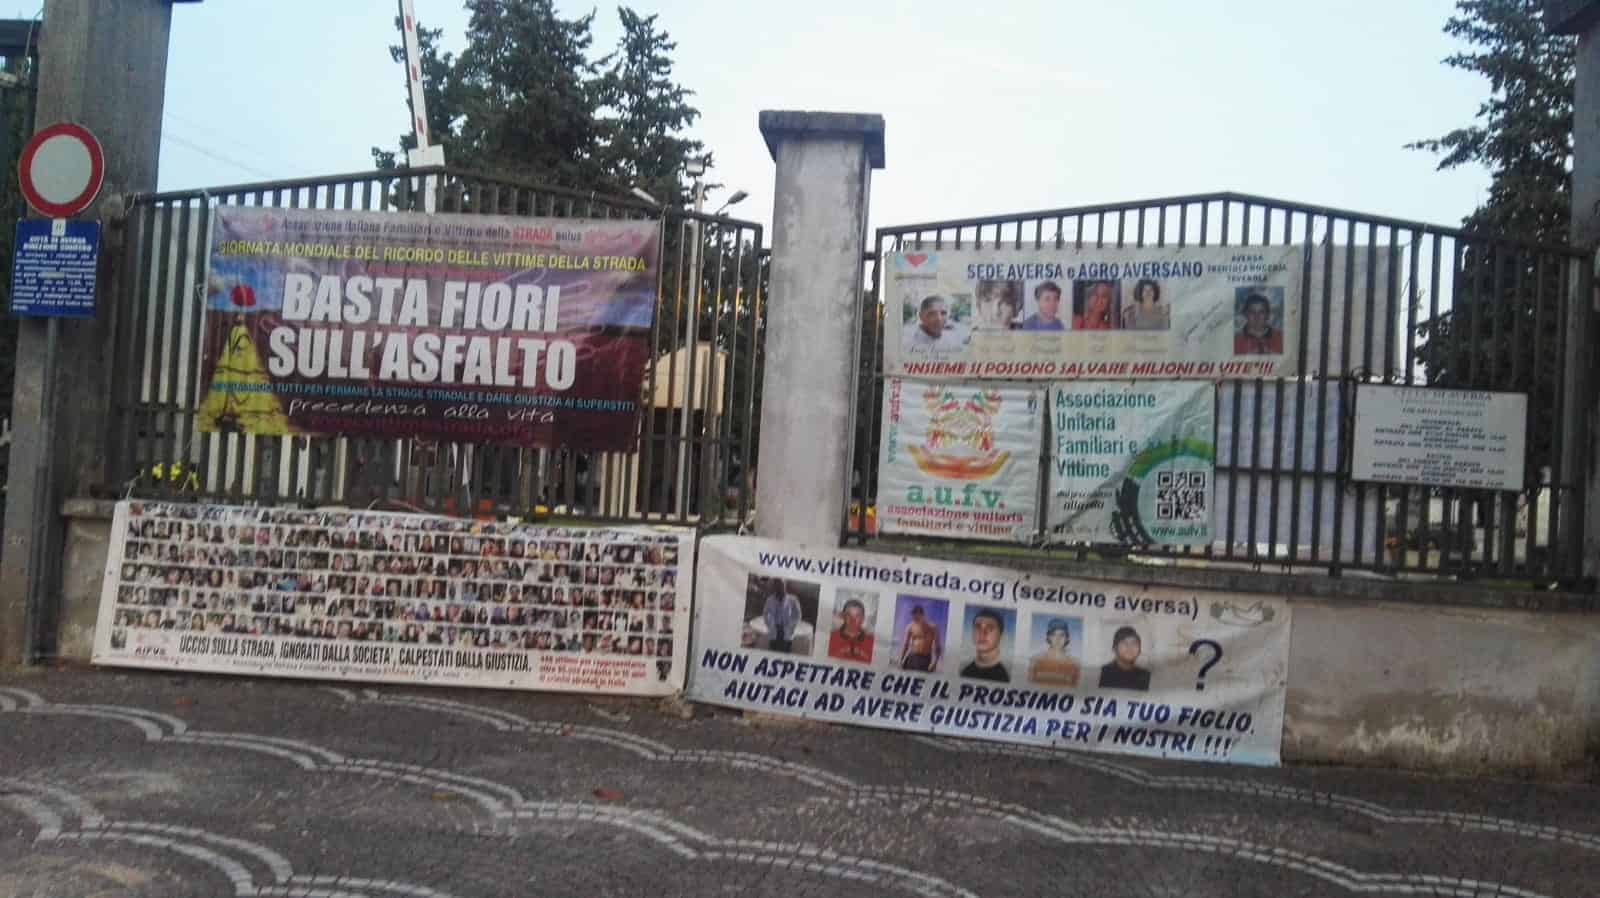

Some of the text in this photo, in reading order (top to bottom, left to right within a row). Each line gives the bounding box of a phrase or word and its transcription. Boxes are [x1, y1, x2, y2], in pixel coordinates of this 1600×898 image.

[512, 226, 552, 241] STRADA
[219, 240, 280, 256] GIORNATA
[283, 242, 350, 259] MONDIALE
[354, 245, 379, 260] DEL
[384, 247, 442, 263] RICORDO
[447, 251, 489, 266] DELLE
[494, 253, 543, 268] VITTIME
[548, 255, 588, 270] DELLA
[593, 256, 646, 271] STRADA
[967, 263, 1004, 279] SEDE
[1007, 263, 1063, 279] AVERSA
[1078, 262, 1119, 280] AGRO
[1122, 261, 1203, 278] AVERSANO
[281, 272, 561, 333] BASTA FIORI
[268, 325, 577, 392] SULL'ASFALTO
[970, 362, 981, 375] SI
[984, 362, 1057, 375] POSSONO
[1059, 362, 1127, 377] SALVARE
[1131, 361, 1195, 375] MILIONI
[1197, 361, 1215, 375] DI
[276, 383, 303, 394] TUTTI
[304, 384, 324, 395] PER
[370, 386, 384, 396] LA
[427, 390, 476, 402] STRADALE
[486, 393, 510, 403] DARE
[514, 394, 562, 406] GIUSTIZIA
[1055, 388, 1156, 408] Associazione
[289, 399, 554, 423] precedenza alla vita
[1056, 412, 1116, 431] Unitaria
[1057, 435, 1138, 454] Familiari e
[1056, 458, 1110, 478] Vittime
[906, 483, 1006, 509] a.u.f.v.
[887, 503, 1024, 524] associazione unitaria
[896, 518, 952, 531] familiari
[759, 551, 1200, 621] www.vittimestrada.org (sezione aversa)
[179, 634, 210, 654] UCCISI
[211, 637, 239, 656] SULLA
[239, 639, 279, 661] STRADA,
[279, 640, 321, 661] IGNORATI
[322, 642, 351, 663] DALLA
[399, 647, 455, 669] CALPESTATI
[455, 650, 484, 670] DALLA
[485, 653, 532, 673] GIUSTIZIA.
[1188, 639, 1223, 691] ?
[702, 649, 1255, 735] NON ASPETTARE CHE IL PROSSIMO SIA TUO FIGLIO.
[724, 680, 1233, 757] AIUTACI AD AVERE GIUSTIZIA PER I NOSTRI !!!
